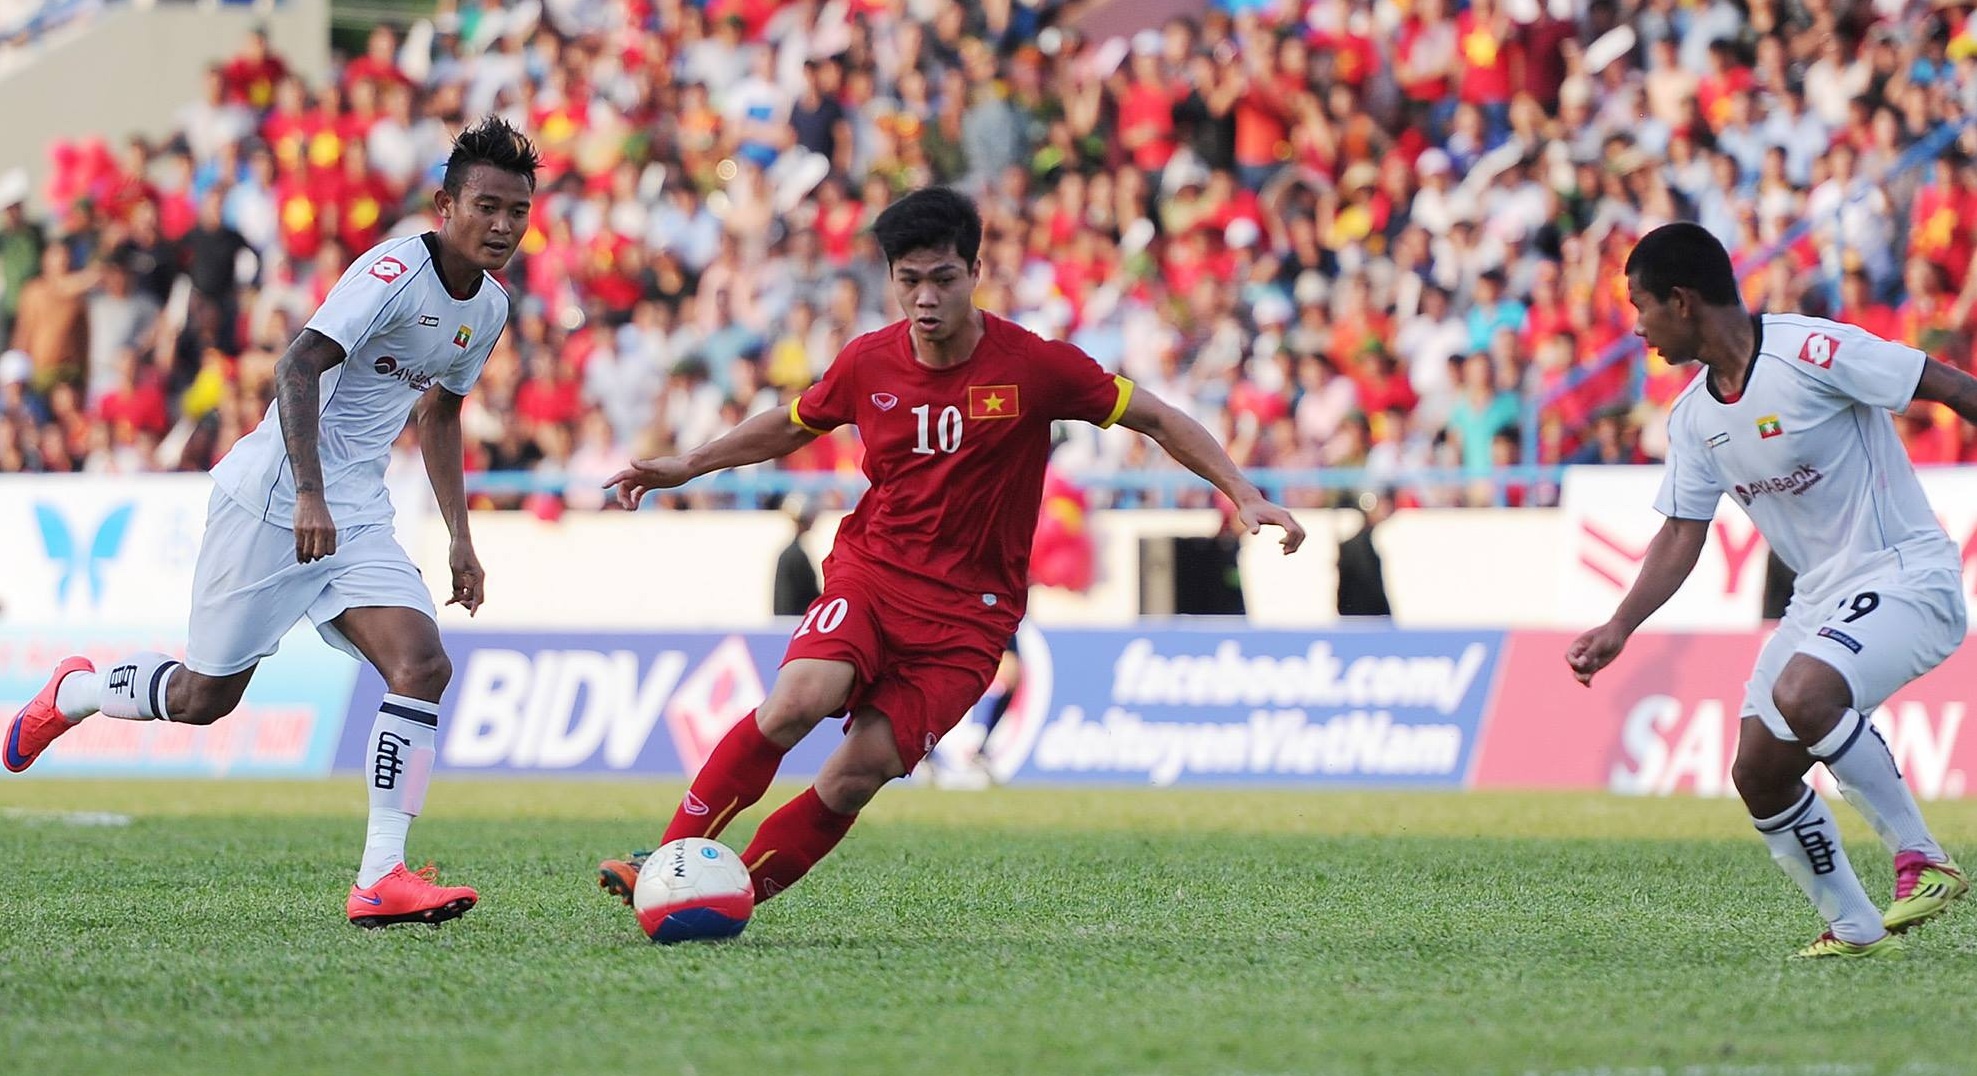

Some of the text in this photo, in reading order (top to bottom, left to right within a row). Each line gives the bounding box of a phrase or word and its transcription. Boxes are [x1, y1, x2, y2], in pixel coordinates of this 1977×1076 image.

[911, 404, 963, 454] 10
[793, 598, 848, 640] 10
[1112, 638, 1487, 714] facebook.com/
[443, 649, 688, 768] BIDV
[375, 731, 411, 790] Lotto
[1793, 817, 1836, 875] Lotto
